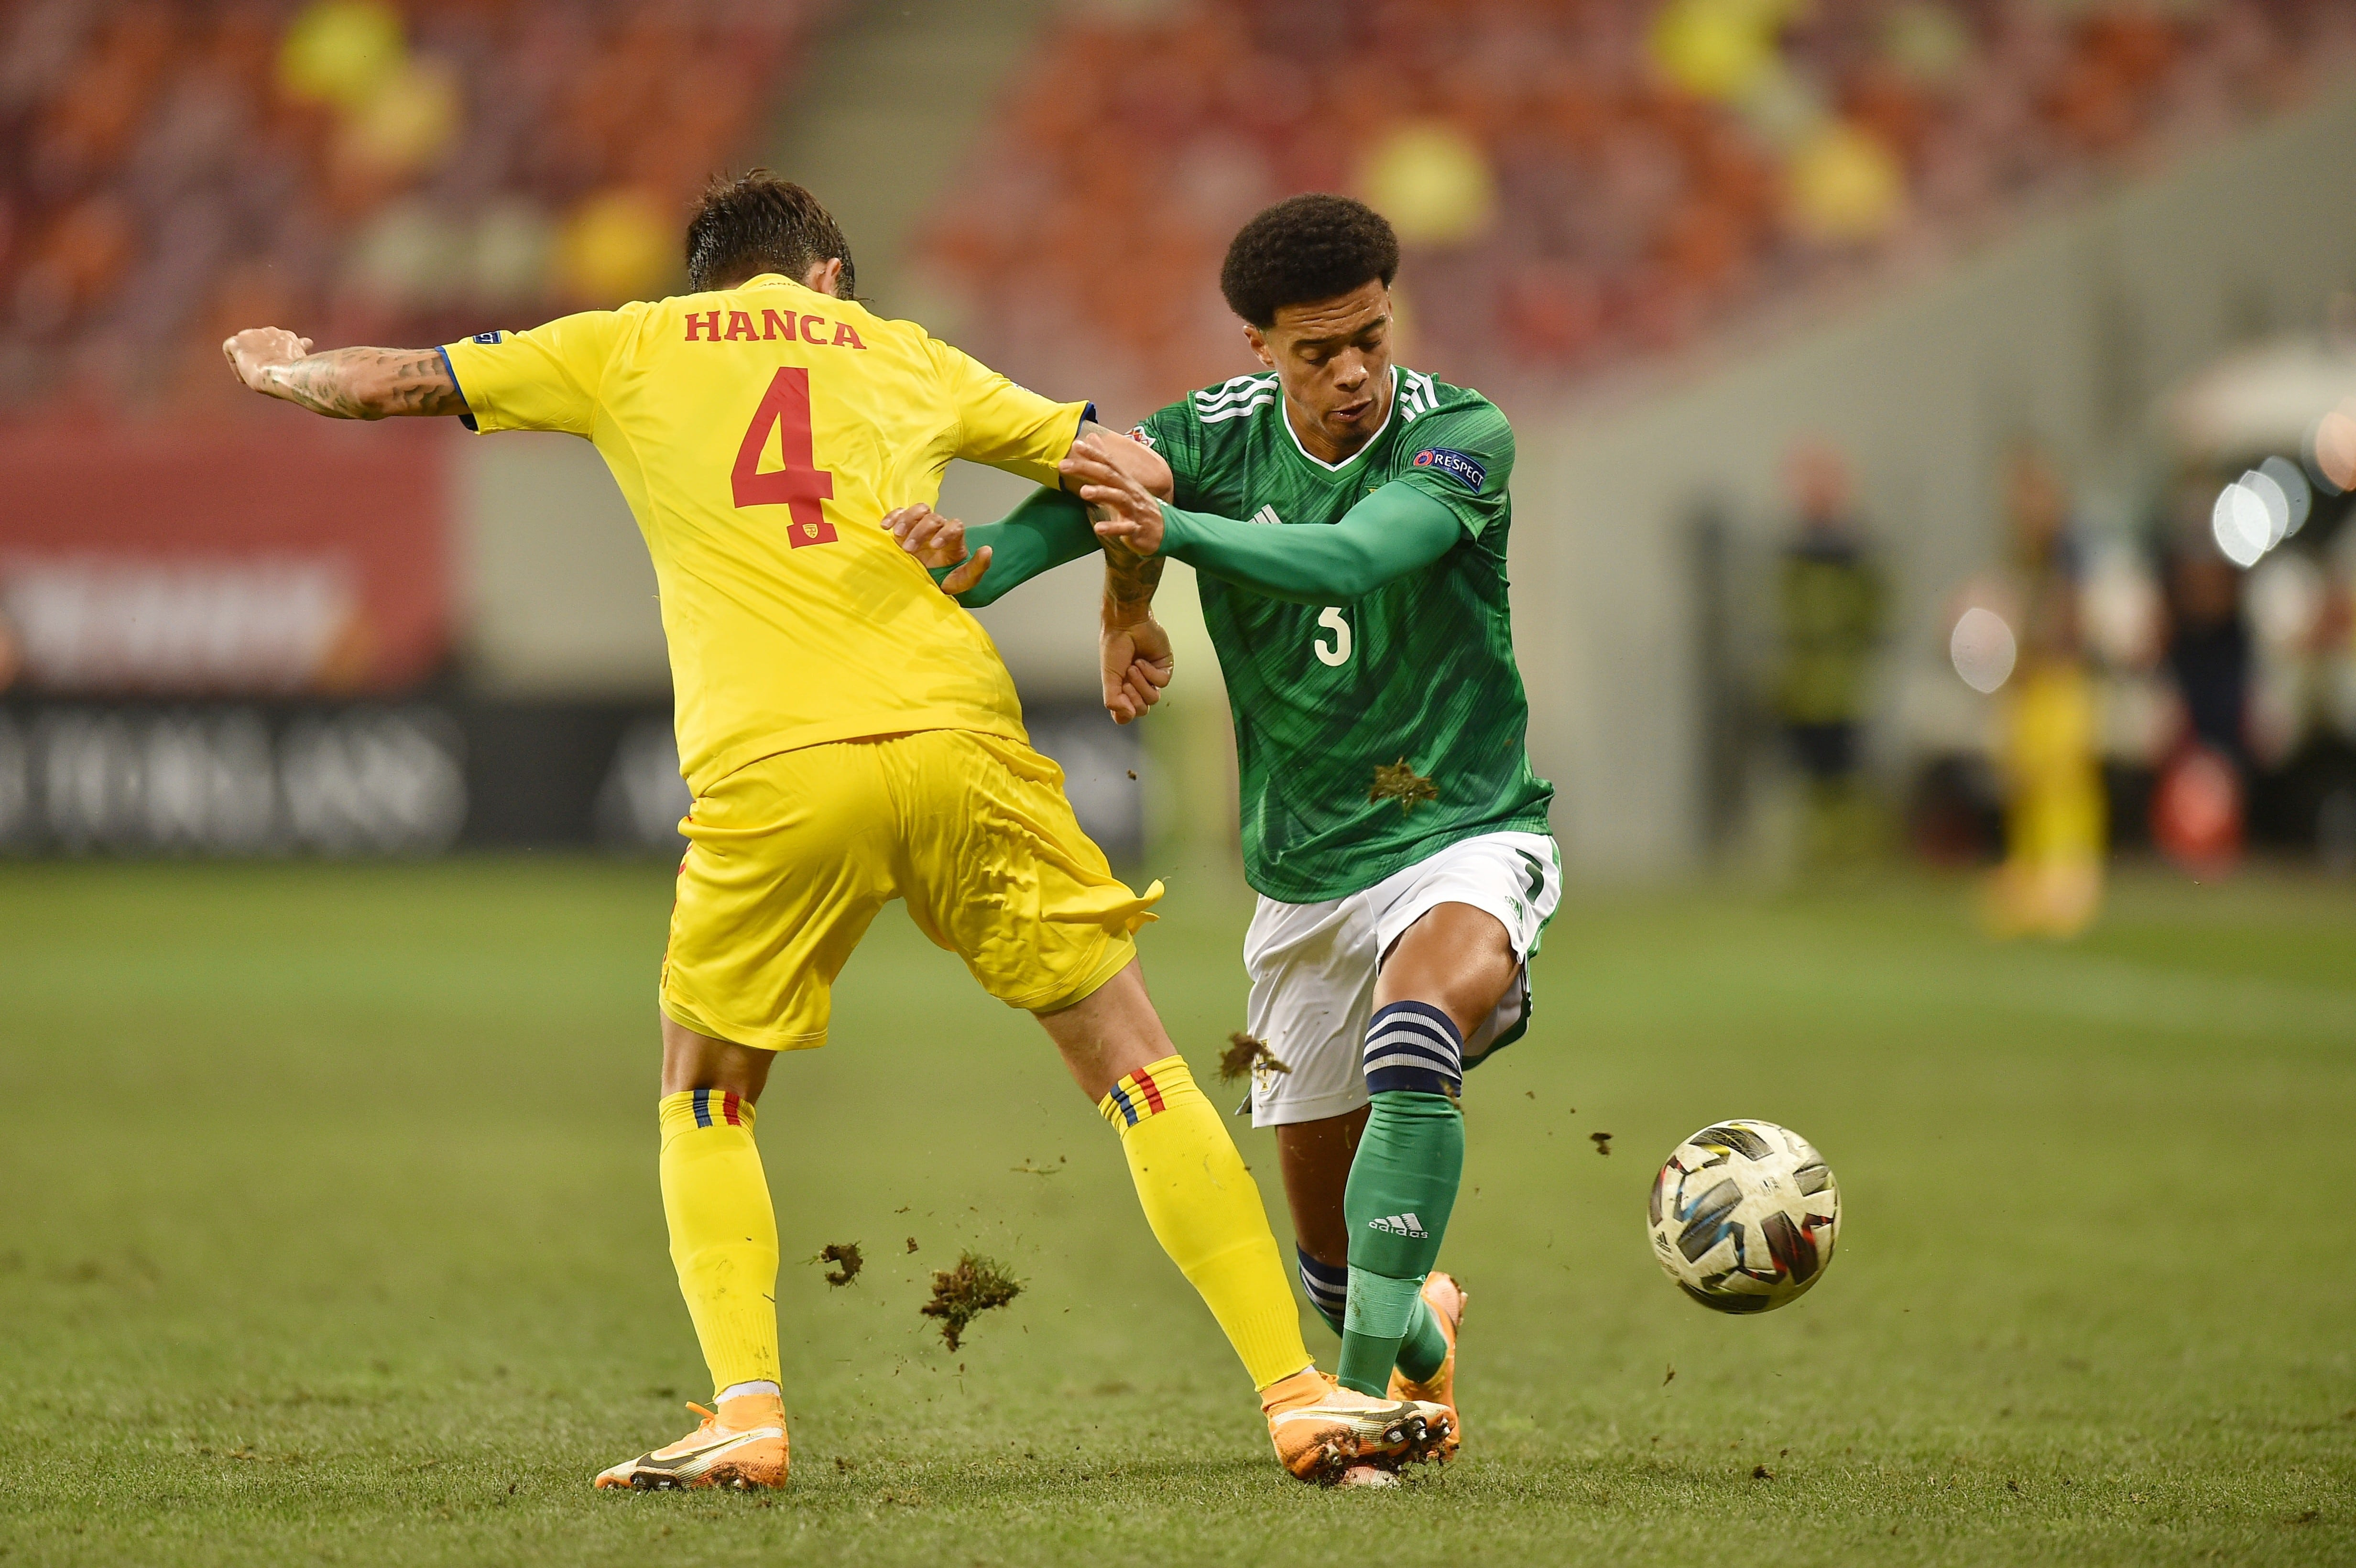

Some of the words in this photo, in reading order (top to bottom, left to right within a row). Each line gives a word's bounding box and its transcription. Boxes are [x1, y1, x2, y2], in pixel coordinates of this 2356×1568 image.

[685, 309, 867, 349] HANCA
[731, 366, 839, 549] 4
[1434, 454, 1484, 486] RESPECT
[1314, 606, 1352, 667] 3
[1368, 1221, 1429, 1239] adidas
